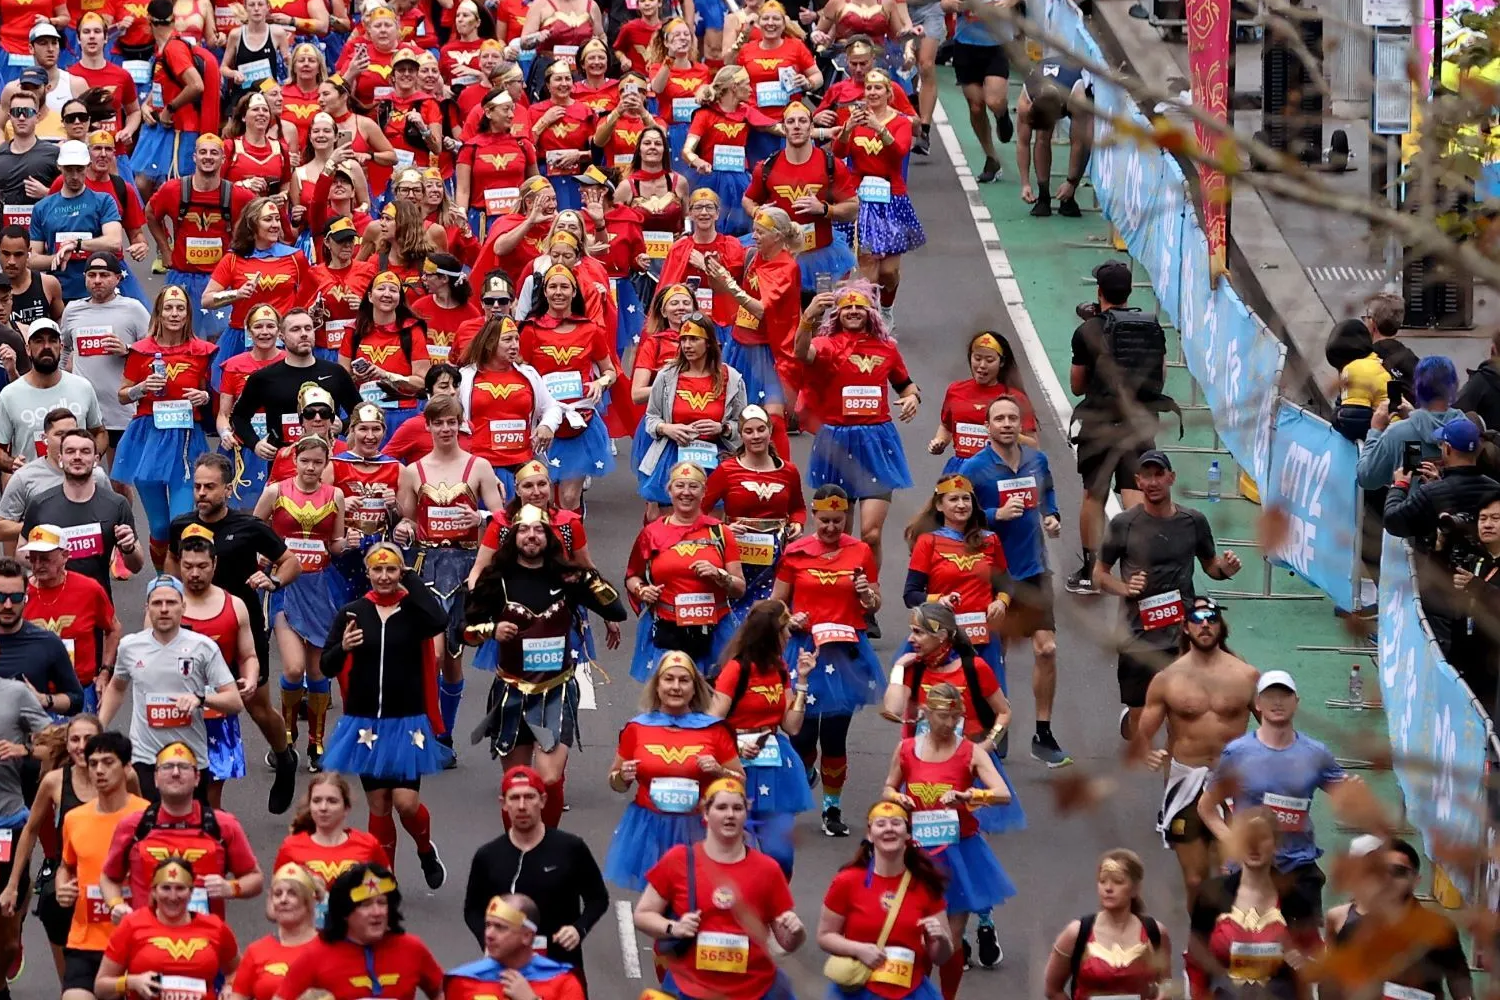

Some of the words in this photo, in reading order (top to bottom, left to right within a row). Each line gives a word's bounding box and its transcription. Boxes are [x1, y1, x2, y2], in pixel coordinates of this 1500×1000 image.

[8, 216, 31, 226] 1289
[189, 248, 220, 258] 60917
[647, 243, 670, 253] 7331
[9, 305, 43, 322] NITE
[845, 399, 879, 409] 88759
[156, 412, 190, 422] 30339
[494, 432, 524, 443] 87976
[682, 451, 713, 463] 31981
[430, 520, 467, 531] 926
[66, 537, 97, 551] 21181
[295, 552, 322, 564] 779
[679, 606, 715, 619] 84657
[1147, 606, 1179, 622] 2988
[525, 652, 564, 664] 46082
[653, 791, 693, 804] 45261
[915, 824, 957, 838] 48873
